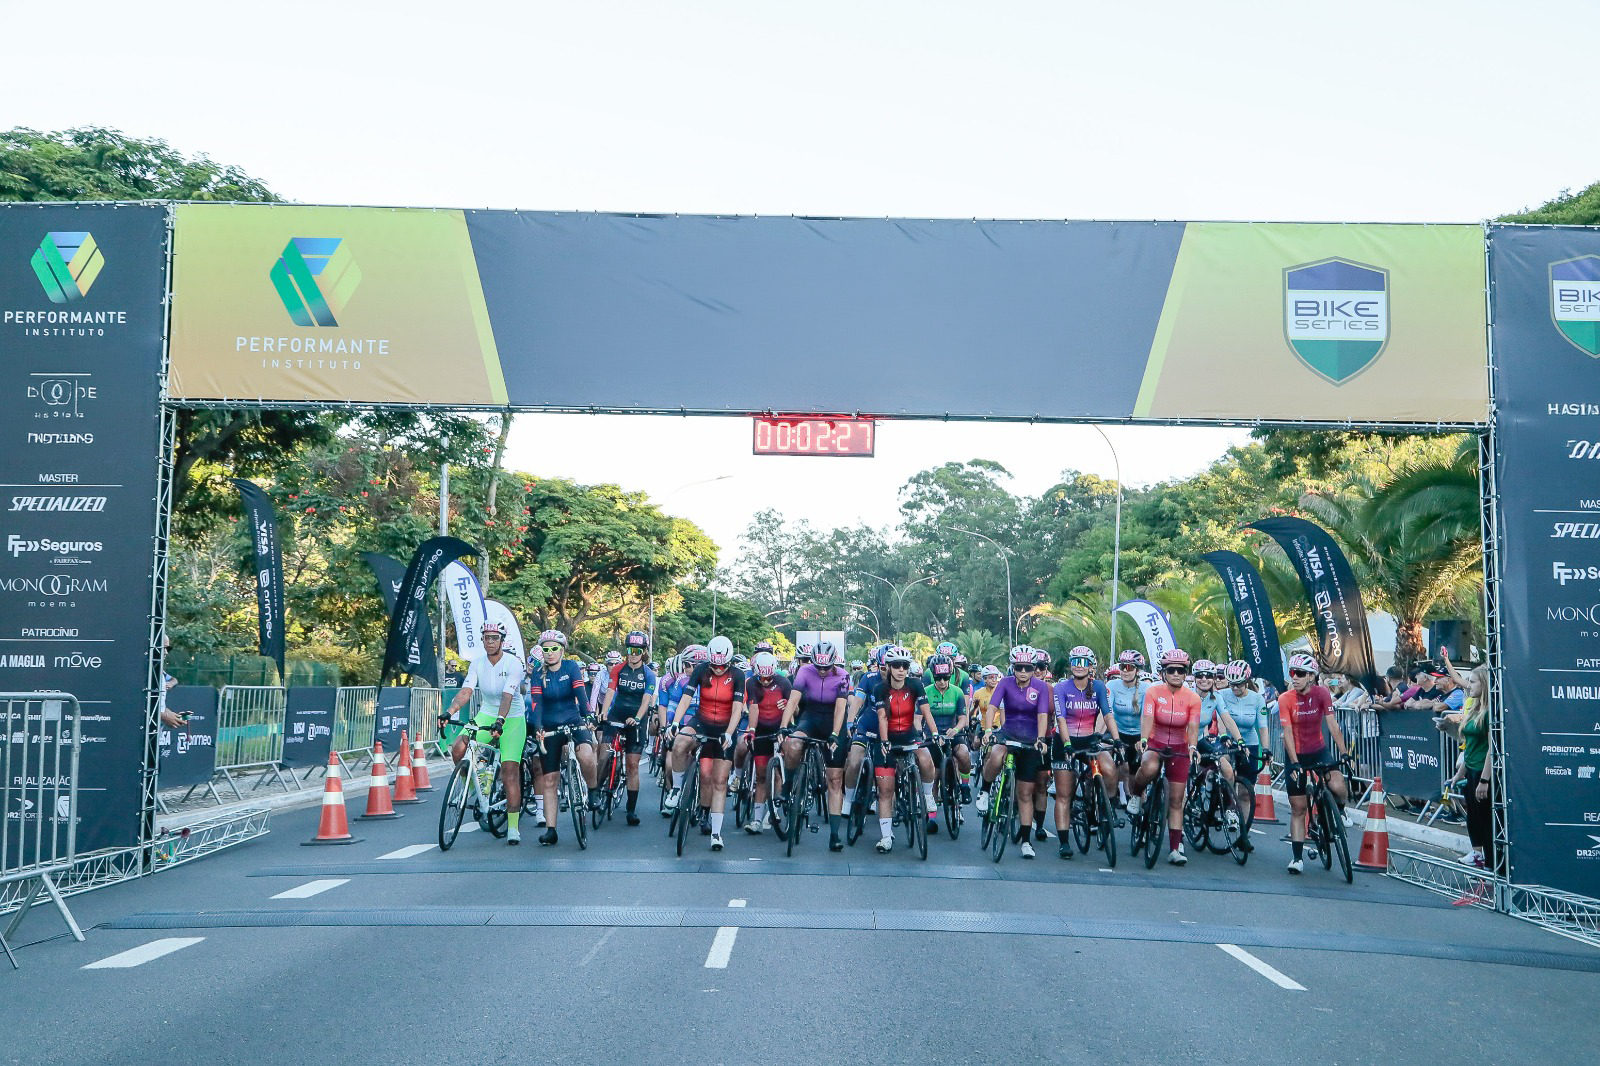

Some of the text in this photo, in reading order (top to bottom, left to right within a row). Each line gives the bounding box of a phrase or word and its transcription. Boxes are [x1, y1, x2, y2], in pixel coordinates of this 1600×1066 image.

[1295, 300, 1379, 317] BIKE
[4, 311, 127, 324] PERFORMANTE
[25, 328, 104, 336] INSTITUTO
[235, 336, 390, 355] PERFORMANTE
[262, 359, 361, 370] INSTITUTO
[757, 421, 871, 451] 00:02:27
[39, 473, 79, 483] MASTER
[8, 496, 107, 512] SPECIALIZED
[259, 520, 269, 555] VISA
[40, 538, 103, 554] Seguros
[1306, 545, 1325, 579] VISA
[0, 574, 108, 596] MONOGRAM
[1235, 572, 1249, 600] VISA
[402, 610, 414, 635] VISA
[462, 601, 475, 648] Seguros
[1320, 610, 1342, 657] primeo
[1245, 626, 1262, 664] primeo
[9, 655, 46, 668] MAGLIA
[1551, 685, 1565, 699] LA
[1389, 746, 1403, 760] VISA
[1541, 745, 1585, 753] PROBIOTICA
[1416, 753, 1438, 768] primeo
